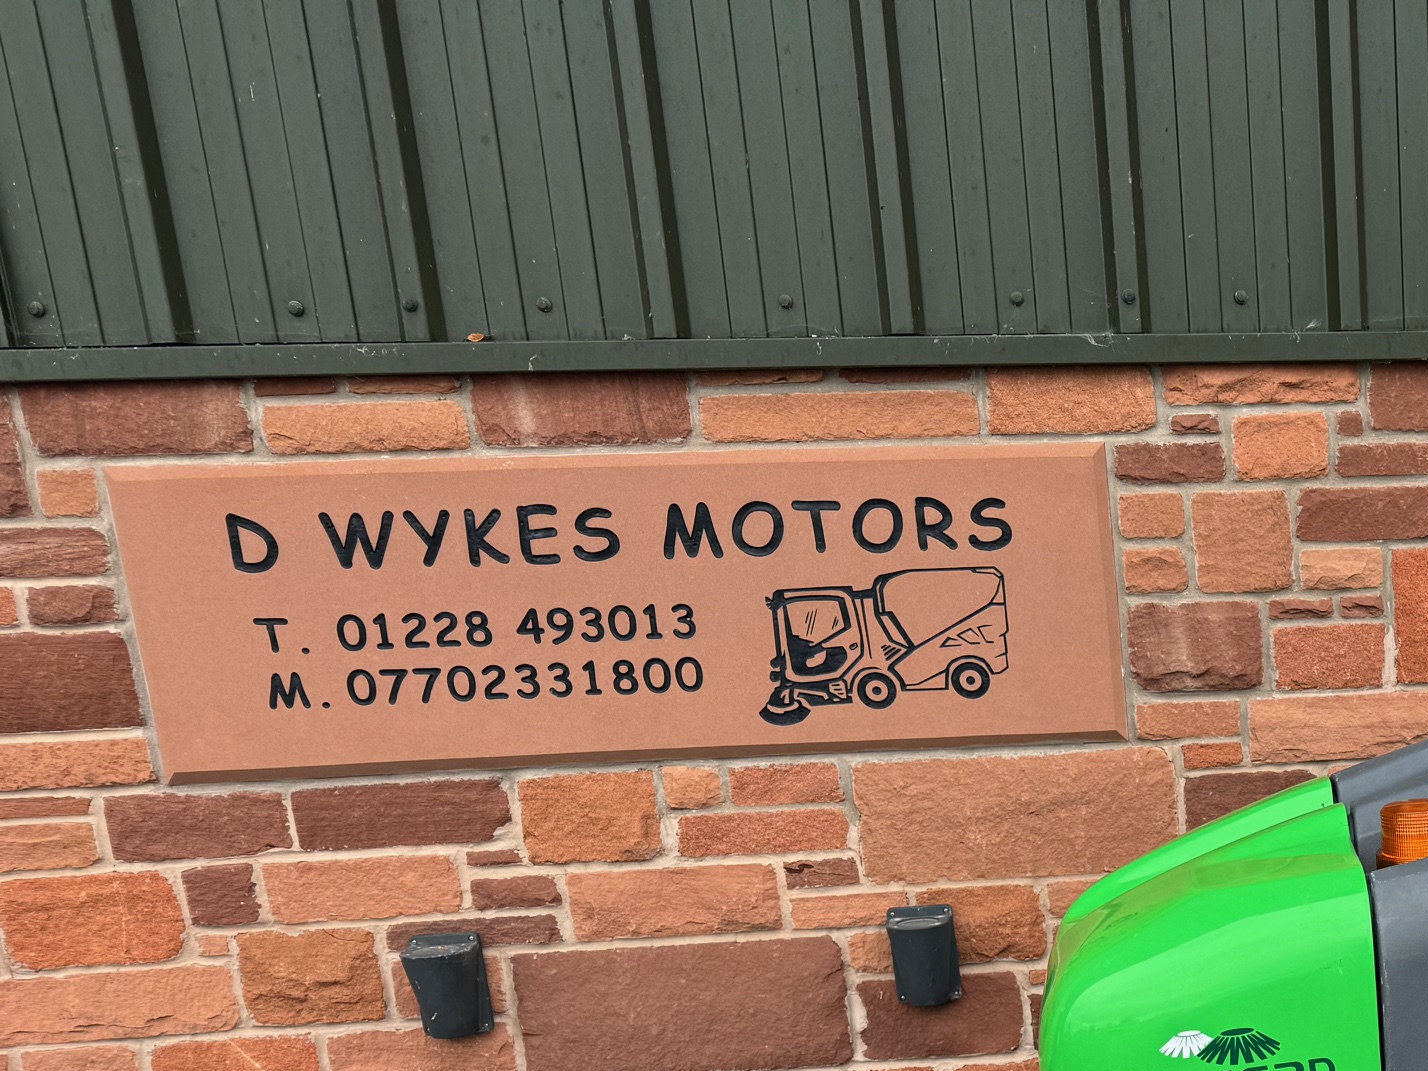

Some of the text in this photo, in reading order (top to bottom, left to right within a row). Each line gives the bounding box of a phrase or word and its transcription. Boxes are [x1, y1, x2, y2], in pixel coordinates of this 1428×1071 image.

[225, 496, 1013, 574] D WYKES MOTORS
[252, 603, 697, 656] T. 01228 493013
[269, 656, 704, 711] M. 07702331800
